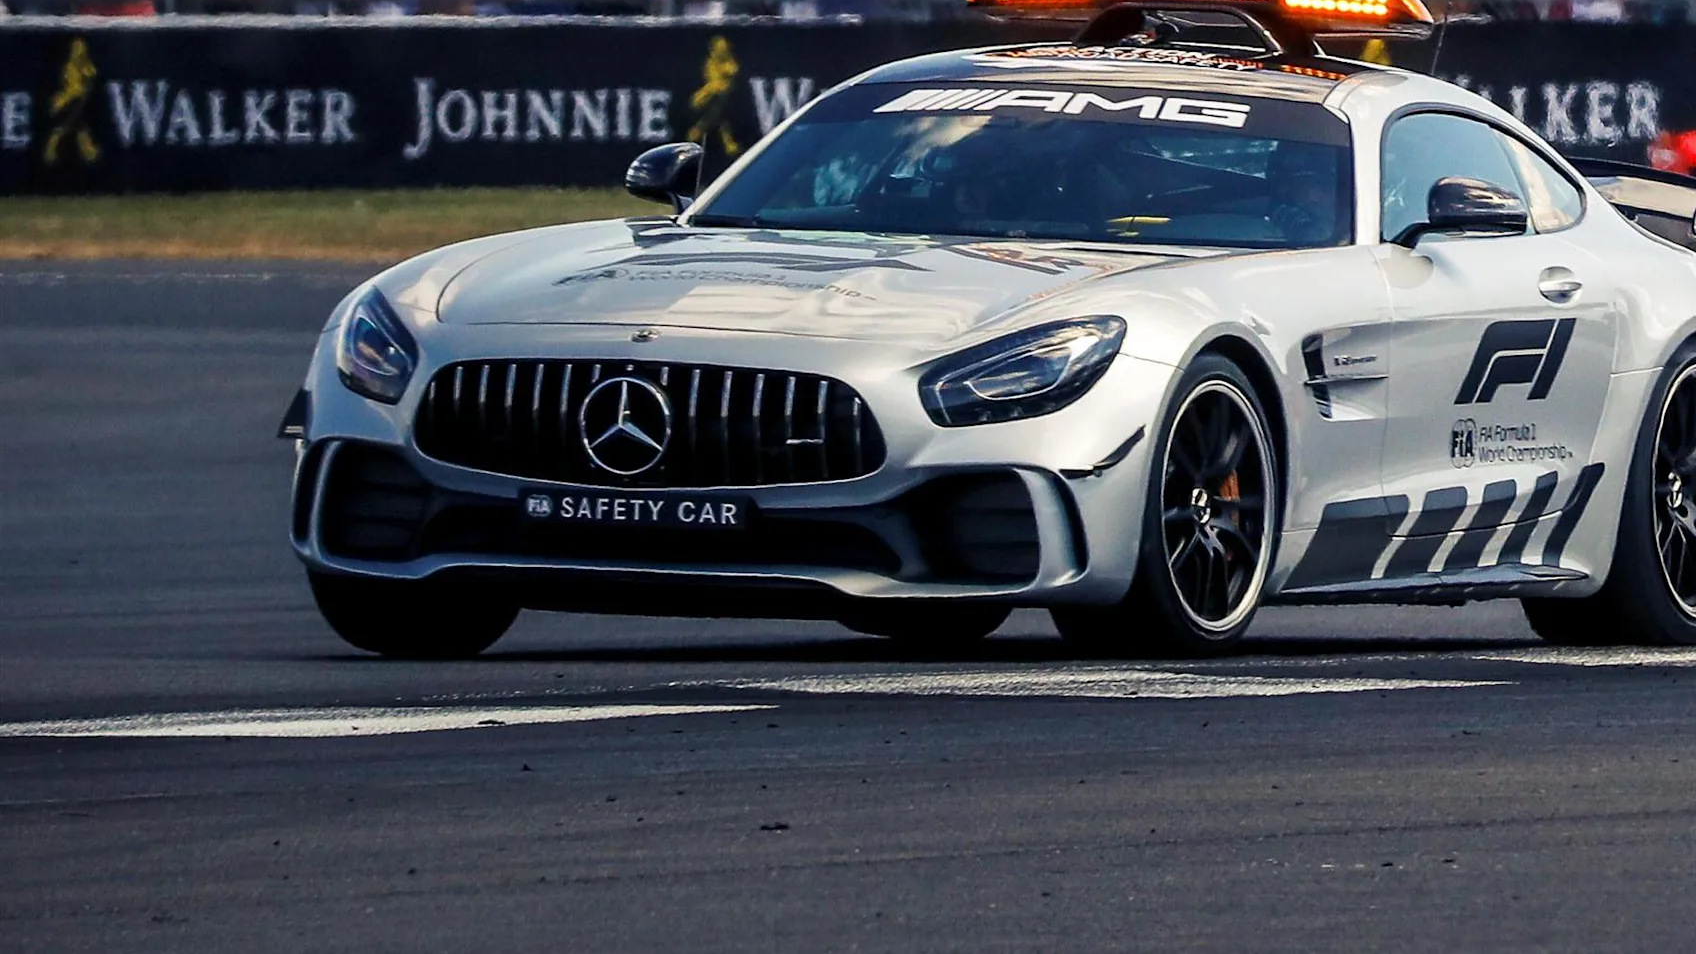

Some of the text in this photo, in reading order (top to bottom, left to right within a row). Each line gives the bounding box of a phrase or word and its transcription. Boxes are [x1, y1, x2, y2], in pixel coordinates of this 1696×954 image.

[105, 79, 356, 145] WALKER
[403, 76, 673, 159] JOHNNIE
[992, 88, 1251, 128] AMG
[1456, 76, 1661, 145] LKER
[1454, 318, 1577, 405] F1
[560, 496, 665, 521] SAFETY
[677, 501, 738, 525] CAR
